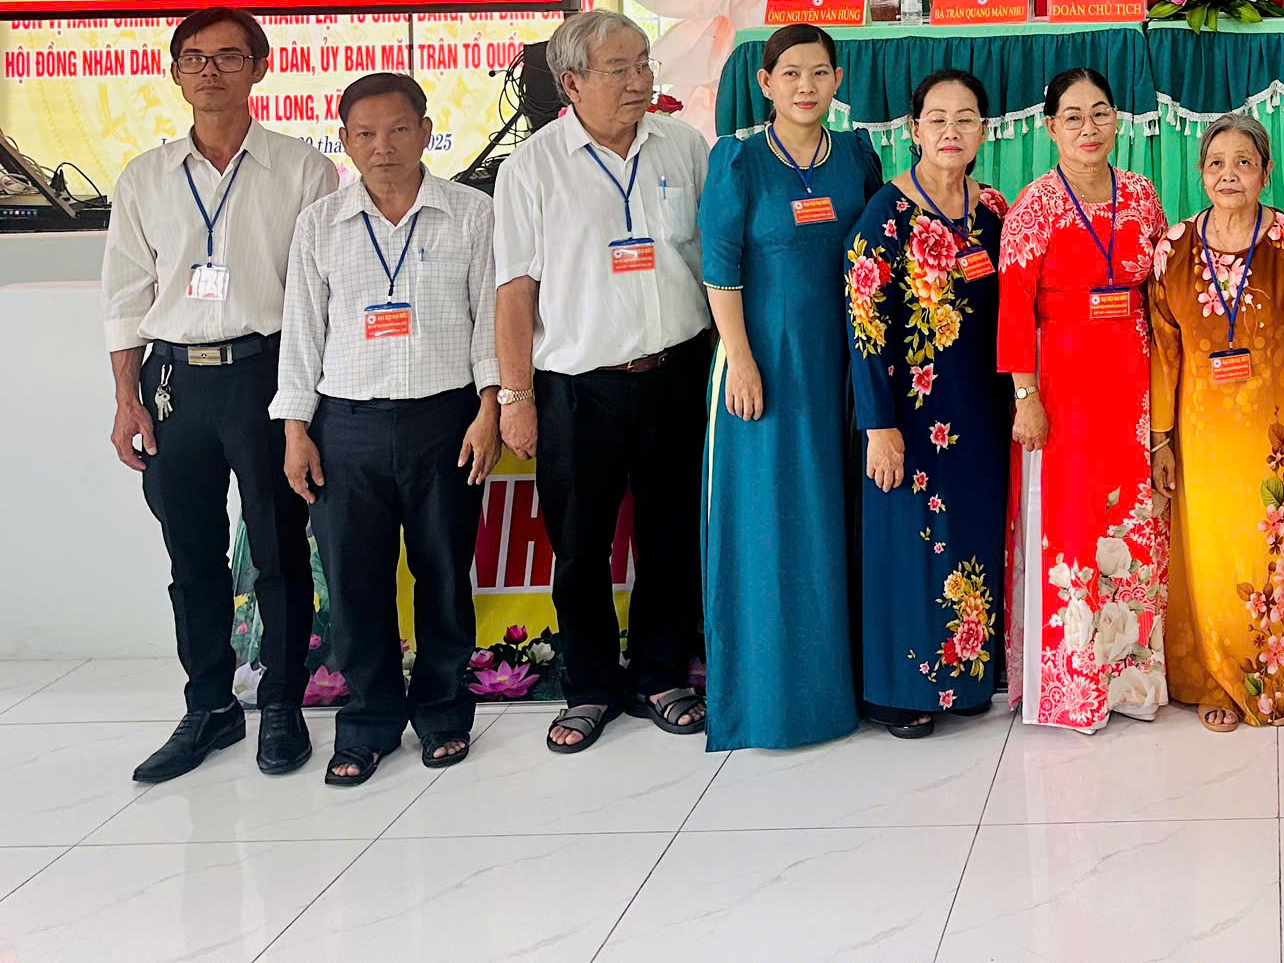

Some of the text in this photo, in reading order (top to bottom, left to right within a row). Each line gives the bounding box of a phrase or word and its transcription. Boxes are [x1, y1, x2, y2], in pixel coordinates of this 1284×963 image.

[965, 8, 991, 19] QUANG
[1052, 2, 1086, 16] ĐOÀN
[1087, 0, 1113, 15] CHỦ
[5, 46, 31, 83] HỘI
[36, 41, 77, 77] ĐỒNG
[82, 45, 125, 76] NHÂN
[130, 44, 167, 79] DÂN,
[279, 41, 316, 76] DÂN,
[320, 36, 341, 72] ỦY
[345, 45, 377, 72] BAN
[418, 38, 458, 76] TRẬN
[462, 31, 481, 69] TỔ
[275, 94, 320, 124] LONG,
